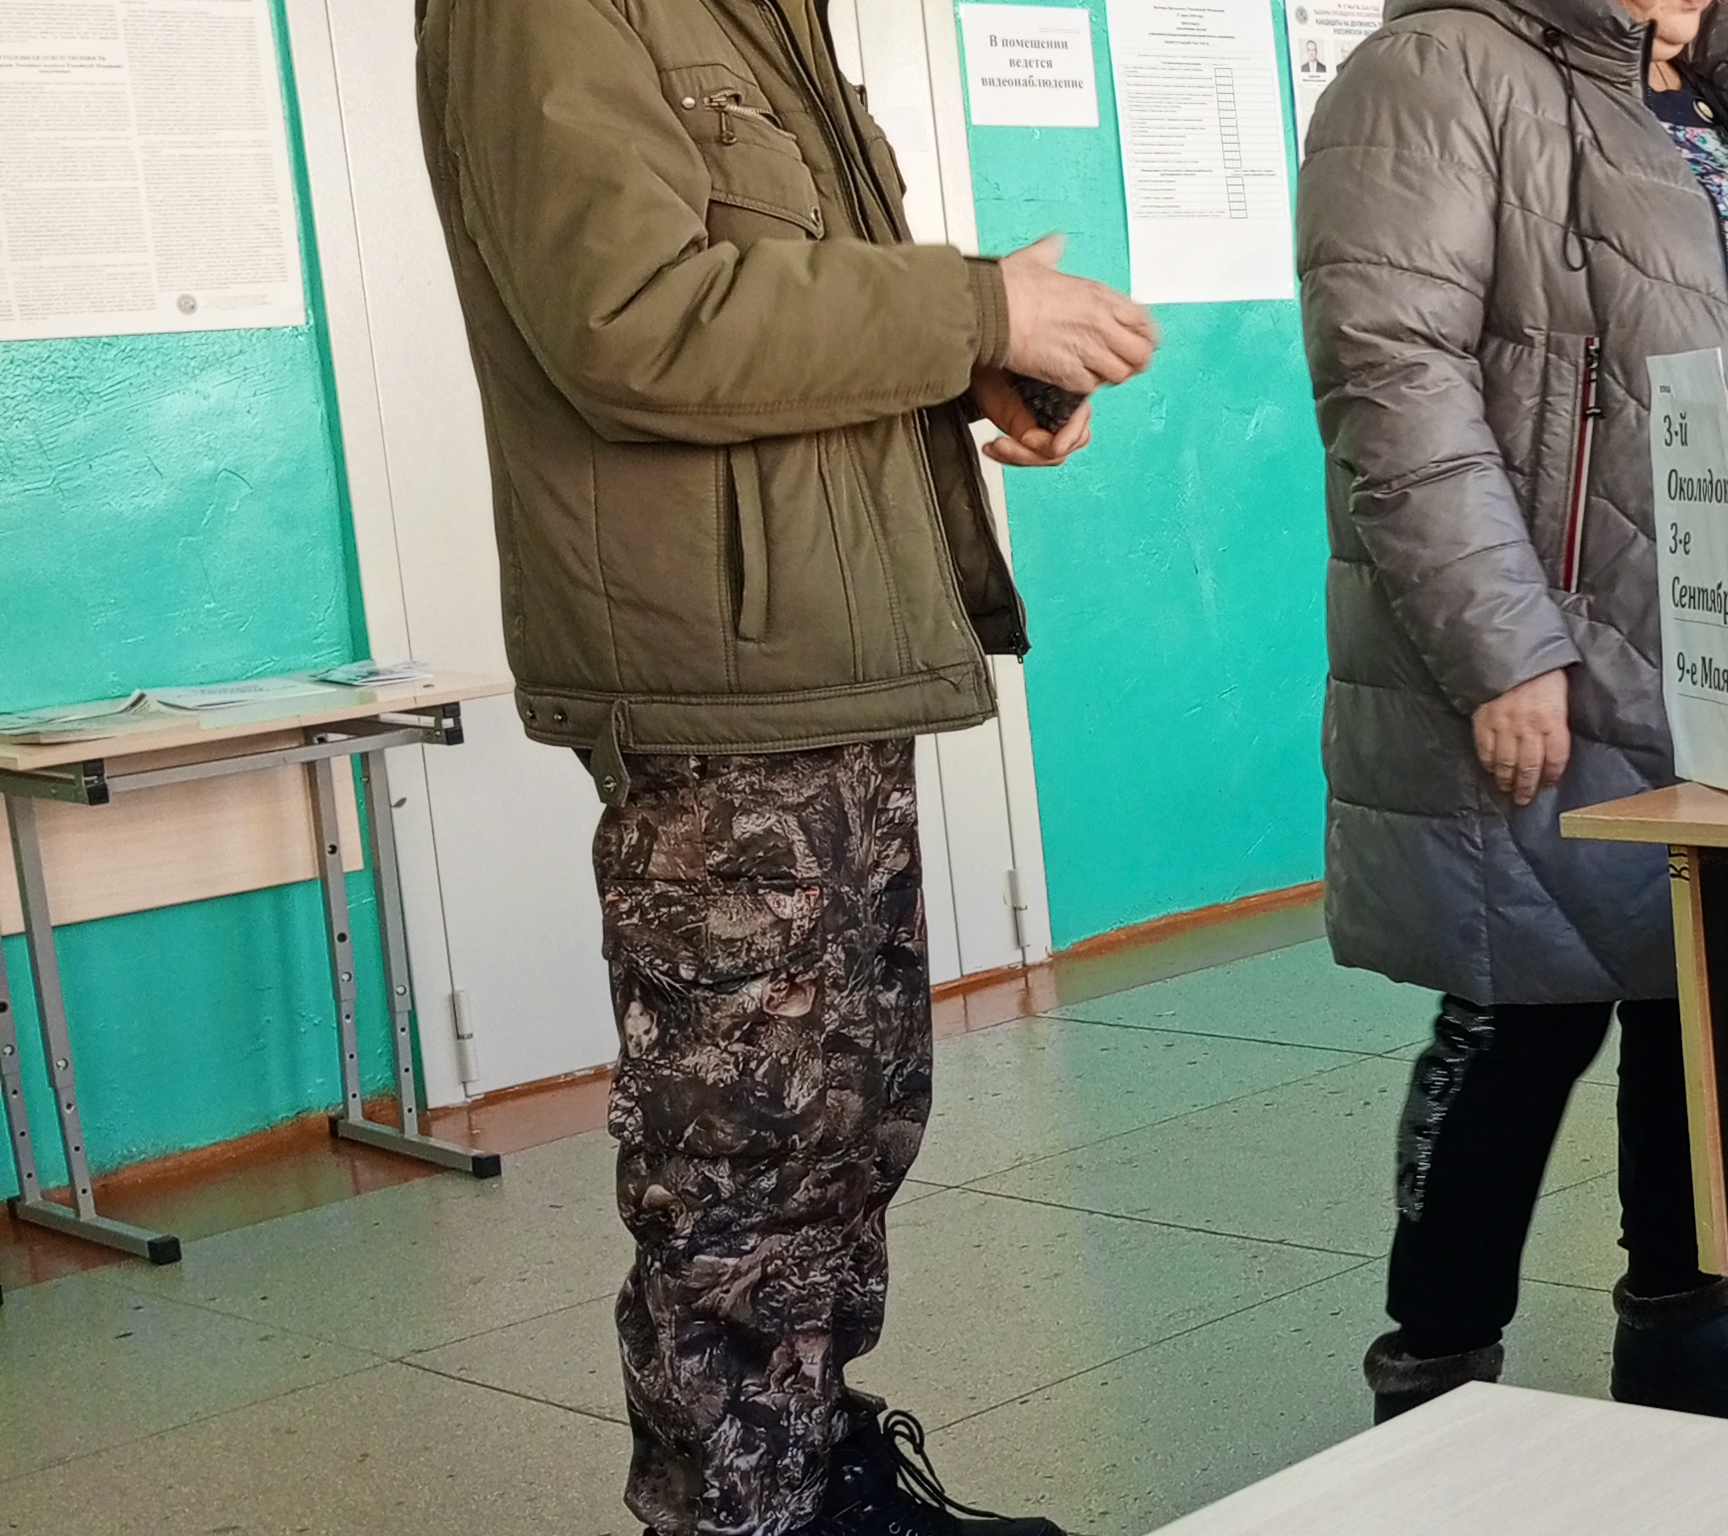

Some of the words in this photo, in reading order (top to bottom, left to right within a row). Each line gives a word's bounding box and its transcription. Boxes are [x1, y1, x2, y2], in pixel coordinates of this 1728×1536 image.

[988, 34, 998, 48] В
[1001, 37, 1069, 50] помещении
[1008, 57, 1053, 69] ведется
[980, 74, 1085, 89] видеонаблюдение
[1663, 412, 1689, 449] 3-й
[1668, 521, 1692, 557] 3-е
[1675, 650, 1699, 685] 9-е
